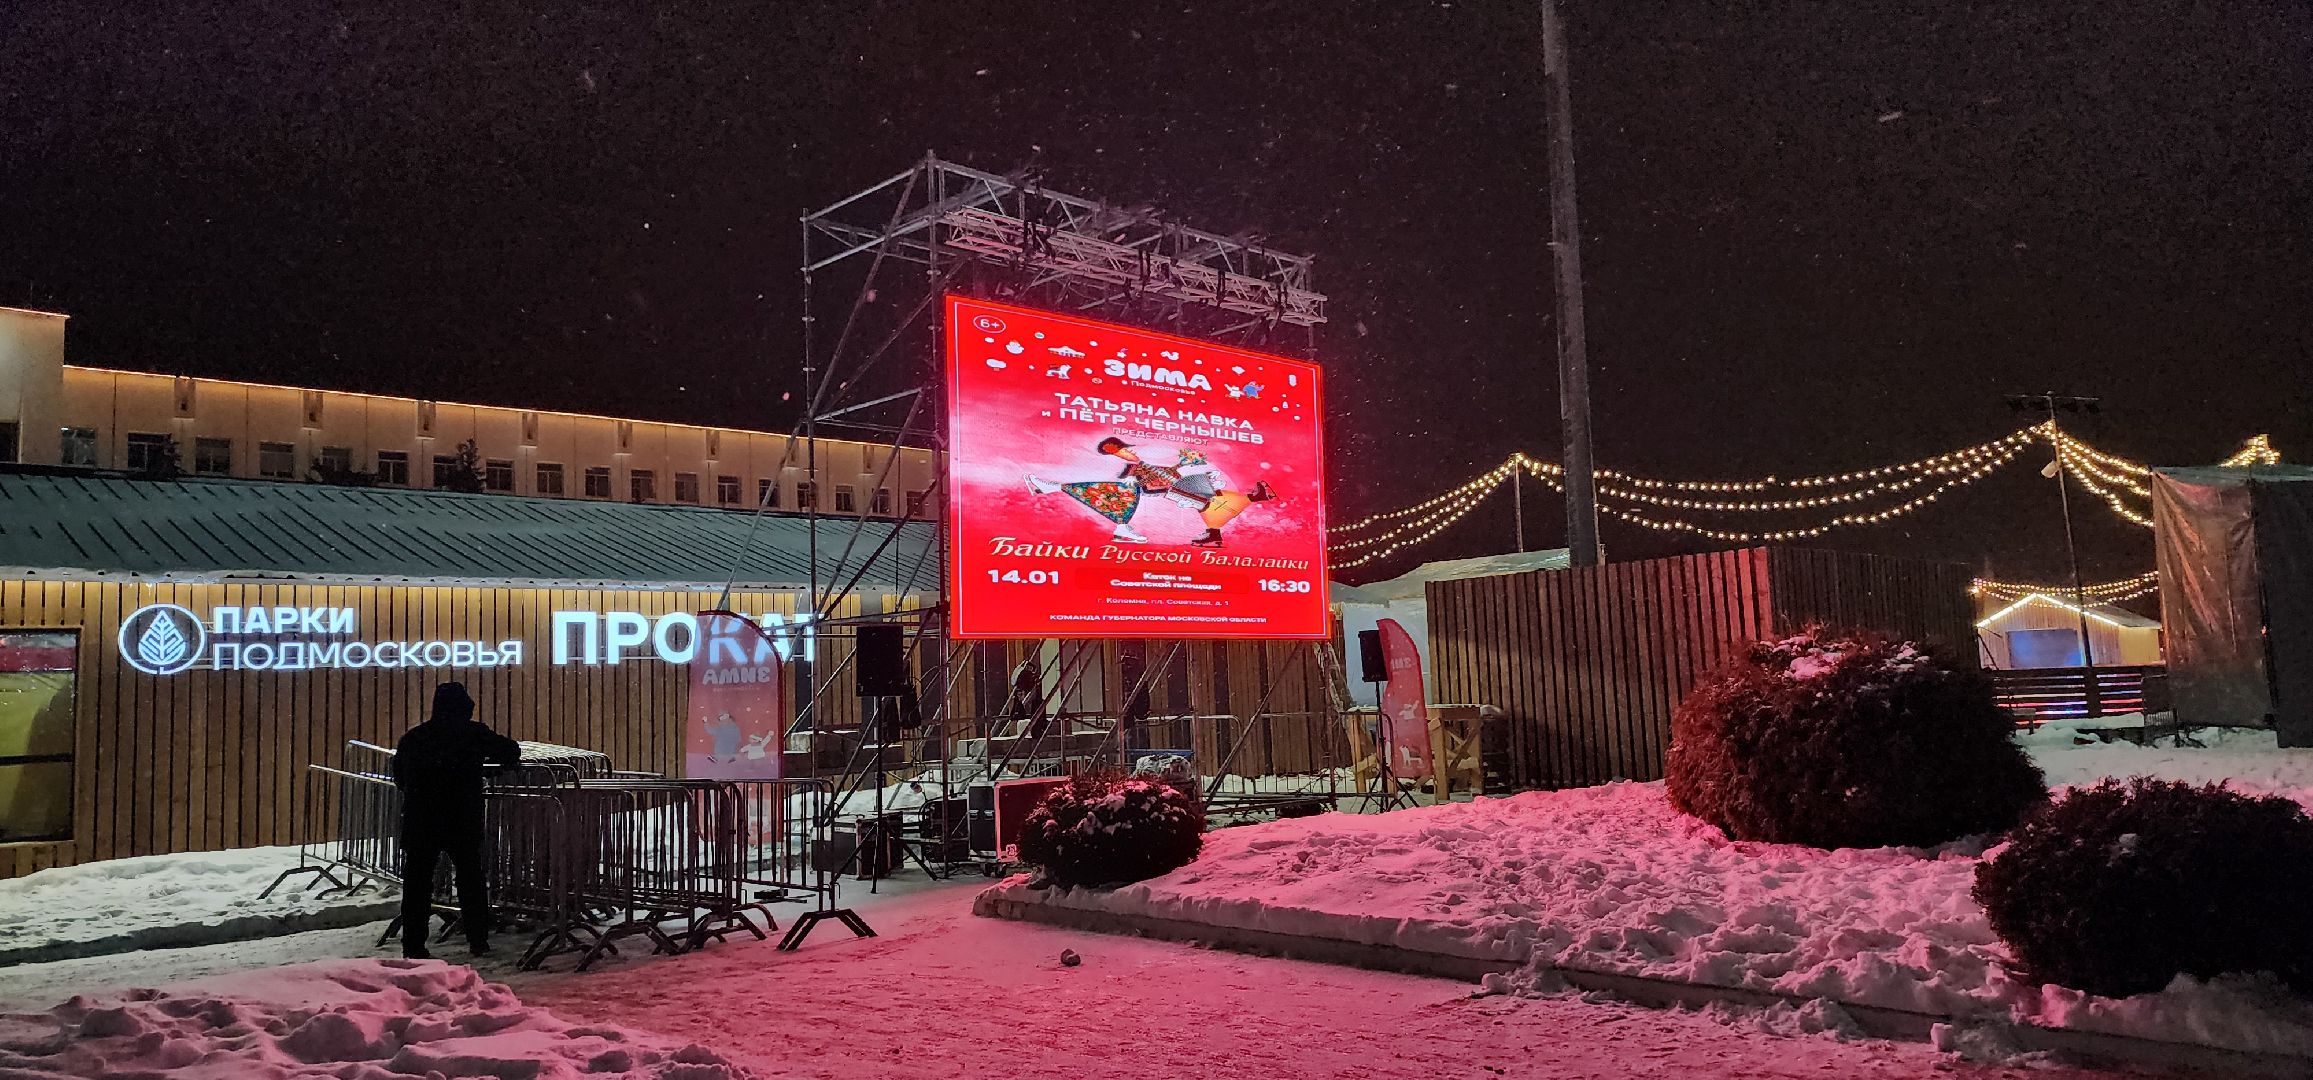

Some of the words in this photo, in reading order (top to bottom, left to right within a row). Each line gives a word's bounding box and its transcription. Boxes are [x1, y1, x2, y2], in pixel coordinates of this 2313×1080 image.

[980, 318, 999, 329] 6+
[1104, 359, 1212, 391] ЗИМА
[1131, 380, 1196, 395] Подмосковье
[1054, 392, 1171, 419] ТАТЬЯНА
[1177, 411, 1255, 431] НАВКА
[1059, 407, 1128, 425] ПЁТР
[1134, 417, 1265, 445] ЧЕРНЫШЕВ
[1112, 427, 1209, 446] ПРЕДСТАВЛЯЮТ
[988, 536, 1090, 560] Байки
[1099, 544, 1192, 564] Русской
[1200, 550, 1309, 570] Балалайки
[987, 569, 1059, 584] 14.01
[1110, 579, 1172, 588] Советской
[1173, 582, 1222, 591] площади
[1142, 572, 1176, 581] Каток
[1257, 579, 1311, 593] 16:30
[213, 606, 355, 634] ПАРКИ
[212, 639, 523, 670] ПОДМОСКОВЬЯ
